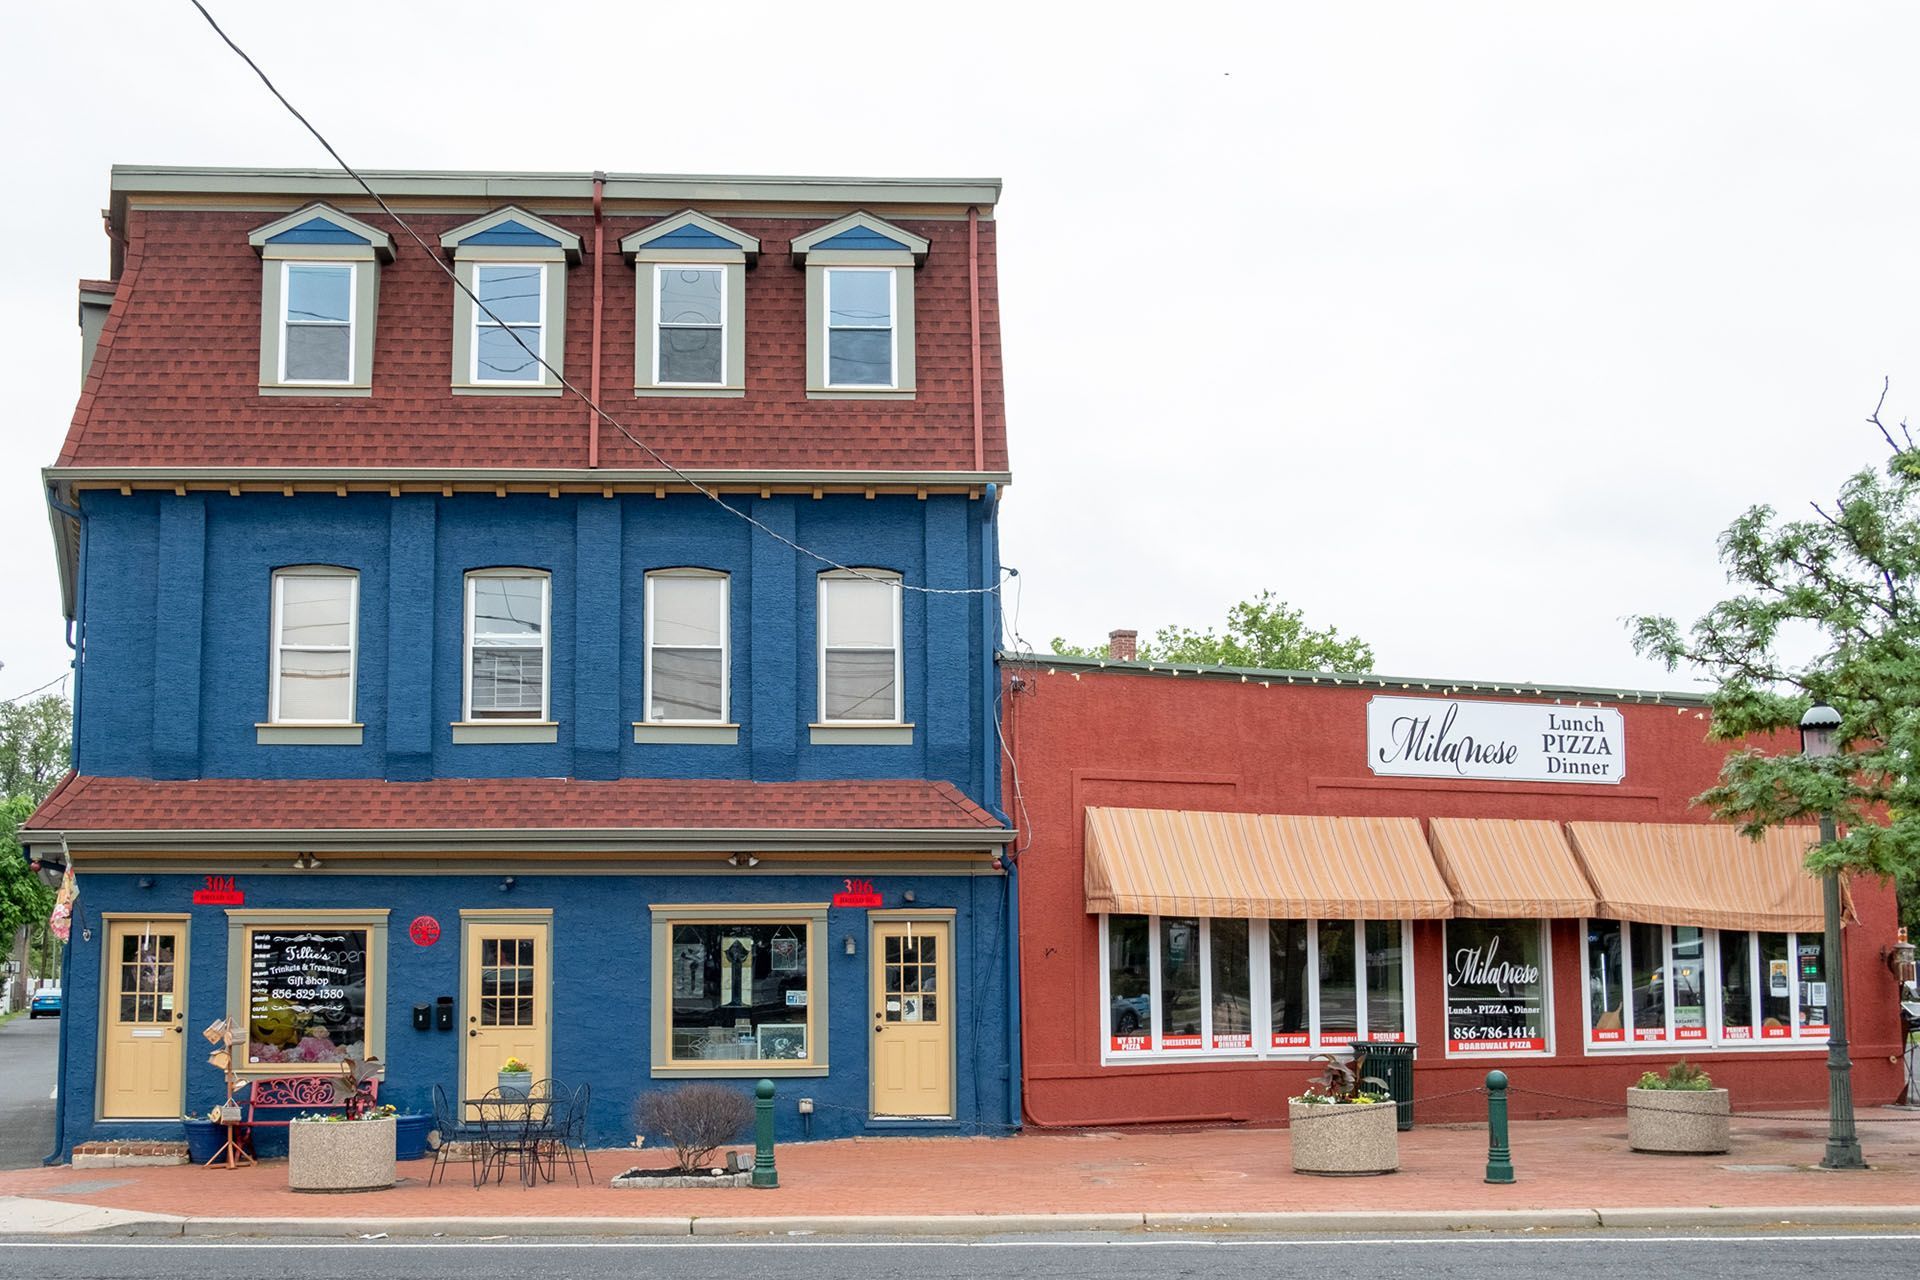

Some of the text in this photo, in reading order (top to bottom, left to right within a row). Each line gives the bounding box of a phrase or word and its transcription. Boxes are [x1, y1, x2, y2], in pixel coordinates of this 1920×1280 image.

[1549, 714, 1604, 733] Lunch
[1379, 703, 1518, 775] Milanese
[1542, 734, 1612, 755] PIZZA
[1547, 757, 1609, 775] Dinner
[203, 875, 235, 892] 304
[843, 879, 873, 895] 306
[285, 945, 331, 961] Tillie's
[269, 964, 300, 975] Trinkets
[302, 963, 309, 971] &
[310, 963, 347, 975] Treasures
[1448, 935, 1539, 993] Milanese
[287, 976, 329, 987] Gift Shop
[272, 988, 344, 999] 856-829-1380
[1448, 1005, 1540, 1014] Lunch PIZZA Dinner
[1117, 1036, 1127, 1044] NY
[1213, 1034, 1250, 1042] HOMEMADE
[1290, 1036, 1307, 1044] SOUP
[1453, 1026, 1536, 1040] 856-786-1414
[1459, 1041, 1531, 1051] BOARDWALK PIZZA
